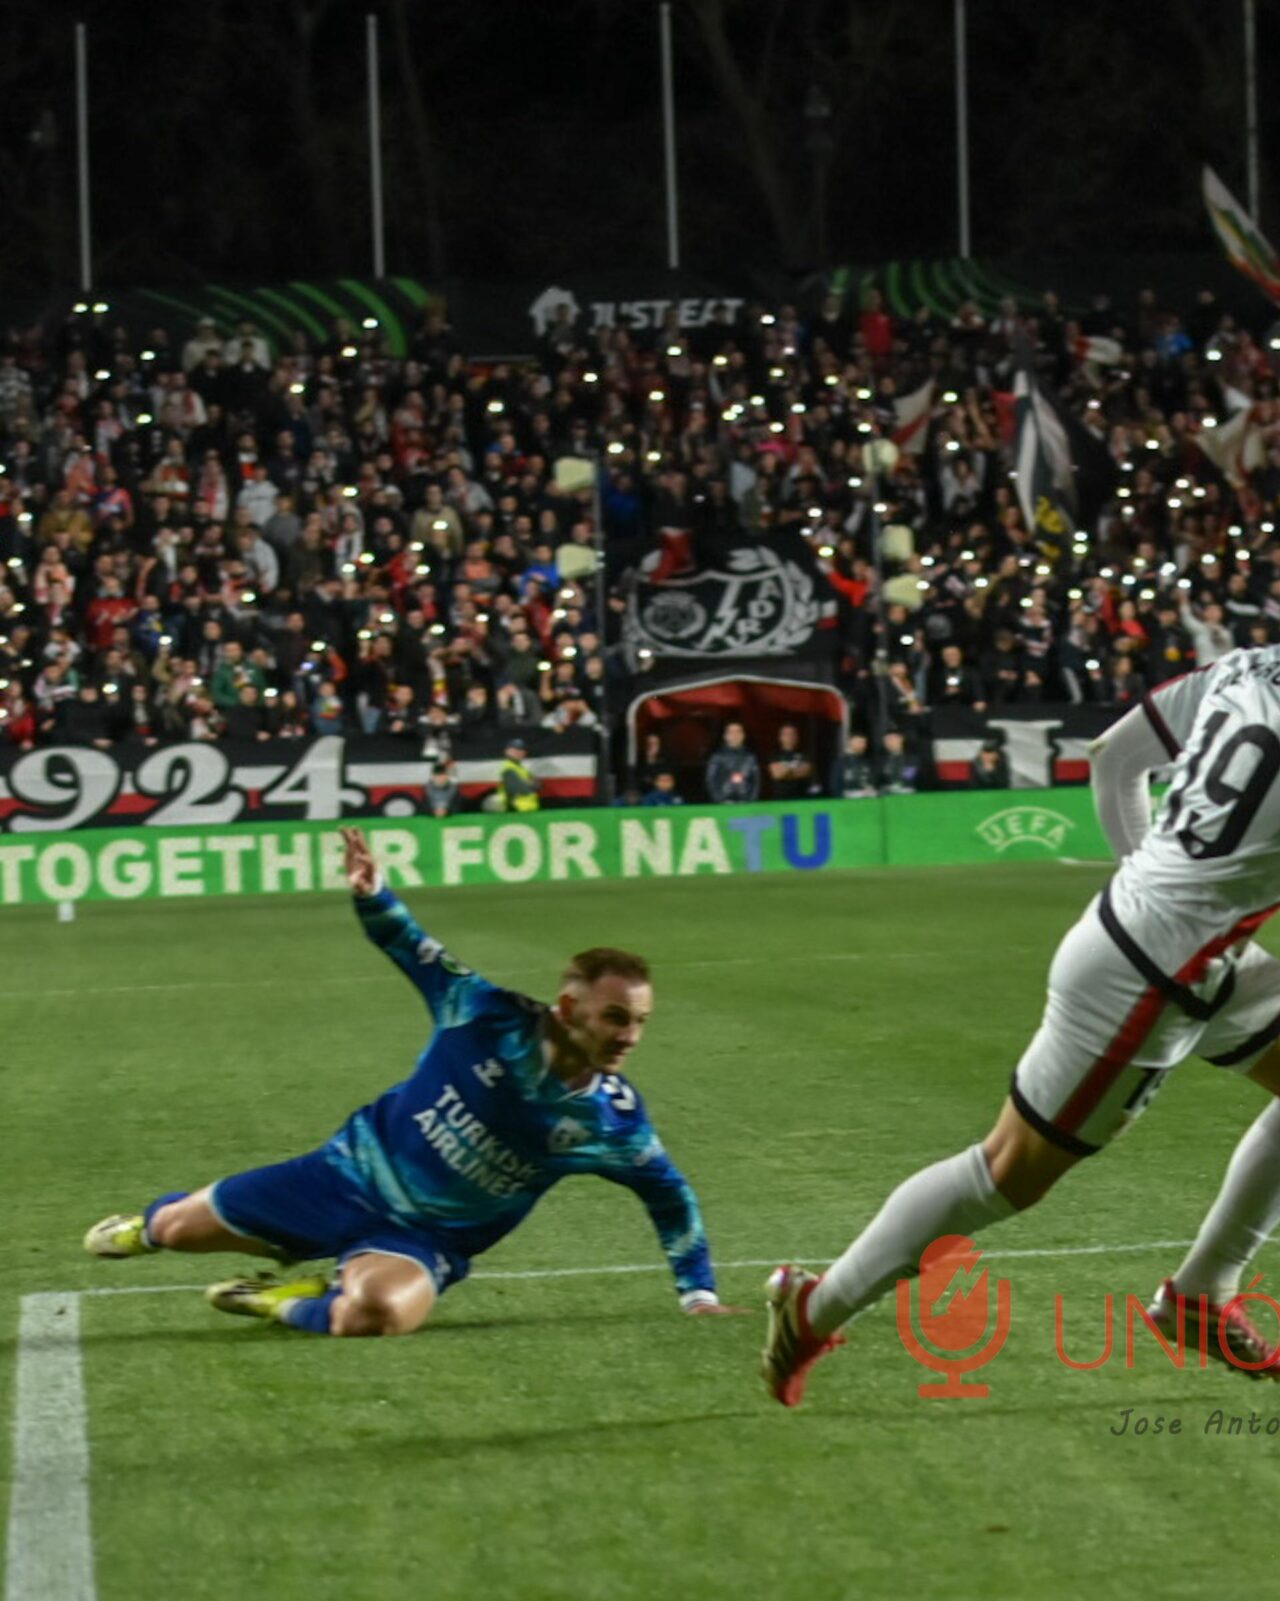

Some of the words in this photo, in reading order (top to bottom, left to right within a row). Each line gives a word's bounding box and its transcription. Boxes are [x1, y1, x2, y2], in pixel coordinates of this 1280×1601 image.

[441, 820, 602, 887] FOR
[621, 812, 832, 877] NATU
[979, 812, 1068, 849] UEFA
[412, 1107, 526, 1199] AIRLINES
[435, 1083, 543, 1179] TURKISH
